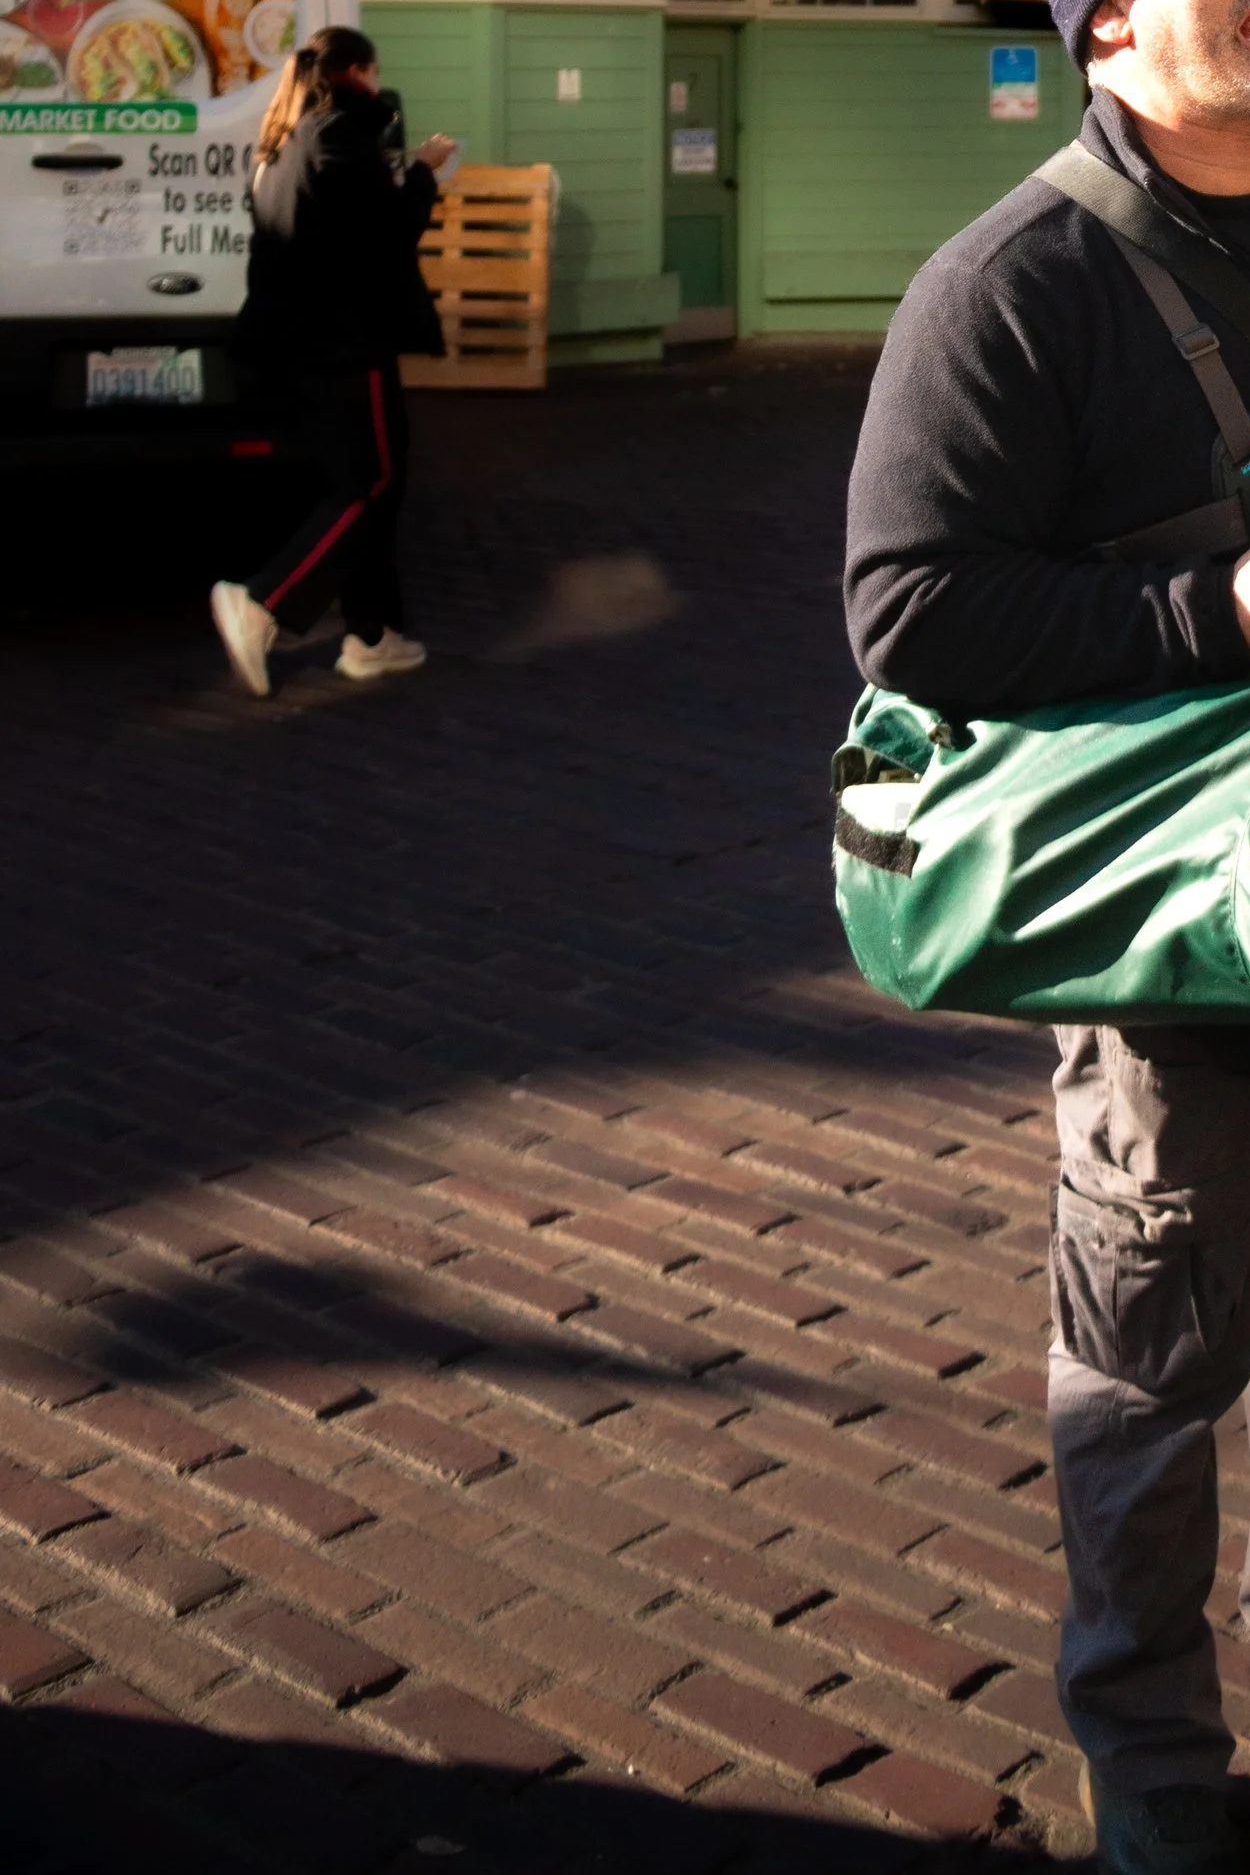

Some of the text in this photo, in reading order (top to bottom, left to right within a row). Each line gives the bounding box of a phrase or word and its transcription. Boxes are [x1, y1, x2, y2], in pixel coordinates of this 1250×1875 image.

[0, 108, 182, 131] MARKET FOOD
[147, 143, 198, 177] Scan
[204, 143, 236, 175] QR
[163, 186, 187, 213] to
[194, 191, 233, 213] see
[160, 225, 251, 255] Full Me
